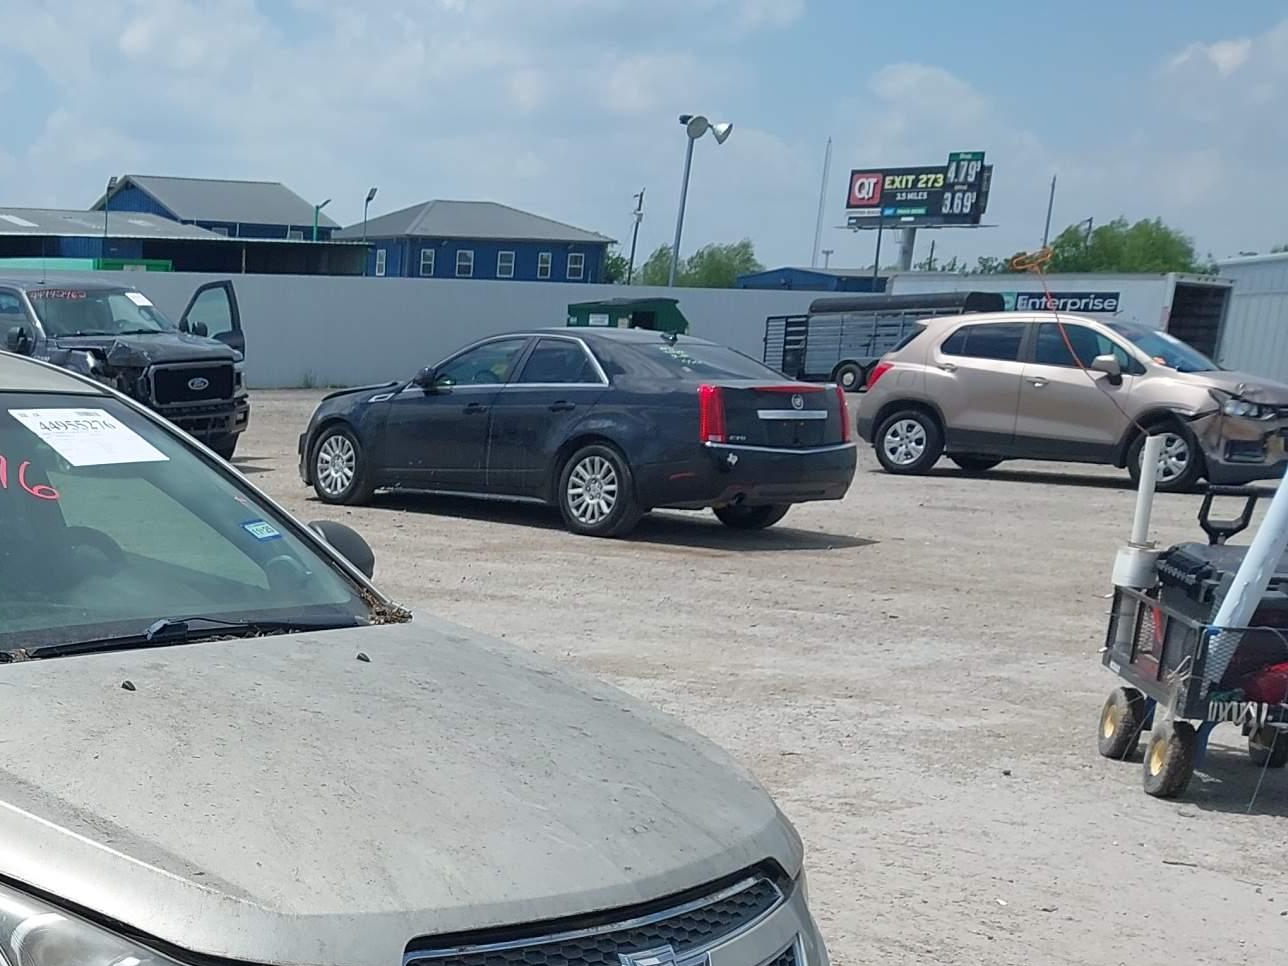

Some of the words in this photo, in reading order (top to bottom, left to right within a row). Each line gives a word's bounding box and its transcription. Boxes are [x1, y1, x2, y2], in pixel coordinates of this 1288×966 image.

[855, 177, 877, 200] QT
[884, 175, 915, 189] EXIT
[917, 174, 944, 188] 273
[907, 192, 928, 200] MILES
[1016, 294, 1117, 312] Enterprise
[39, 419, 117, 432] 44955276
